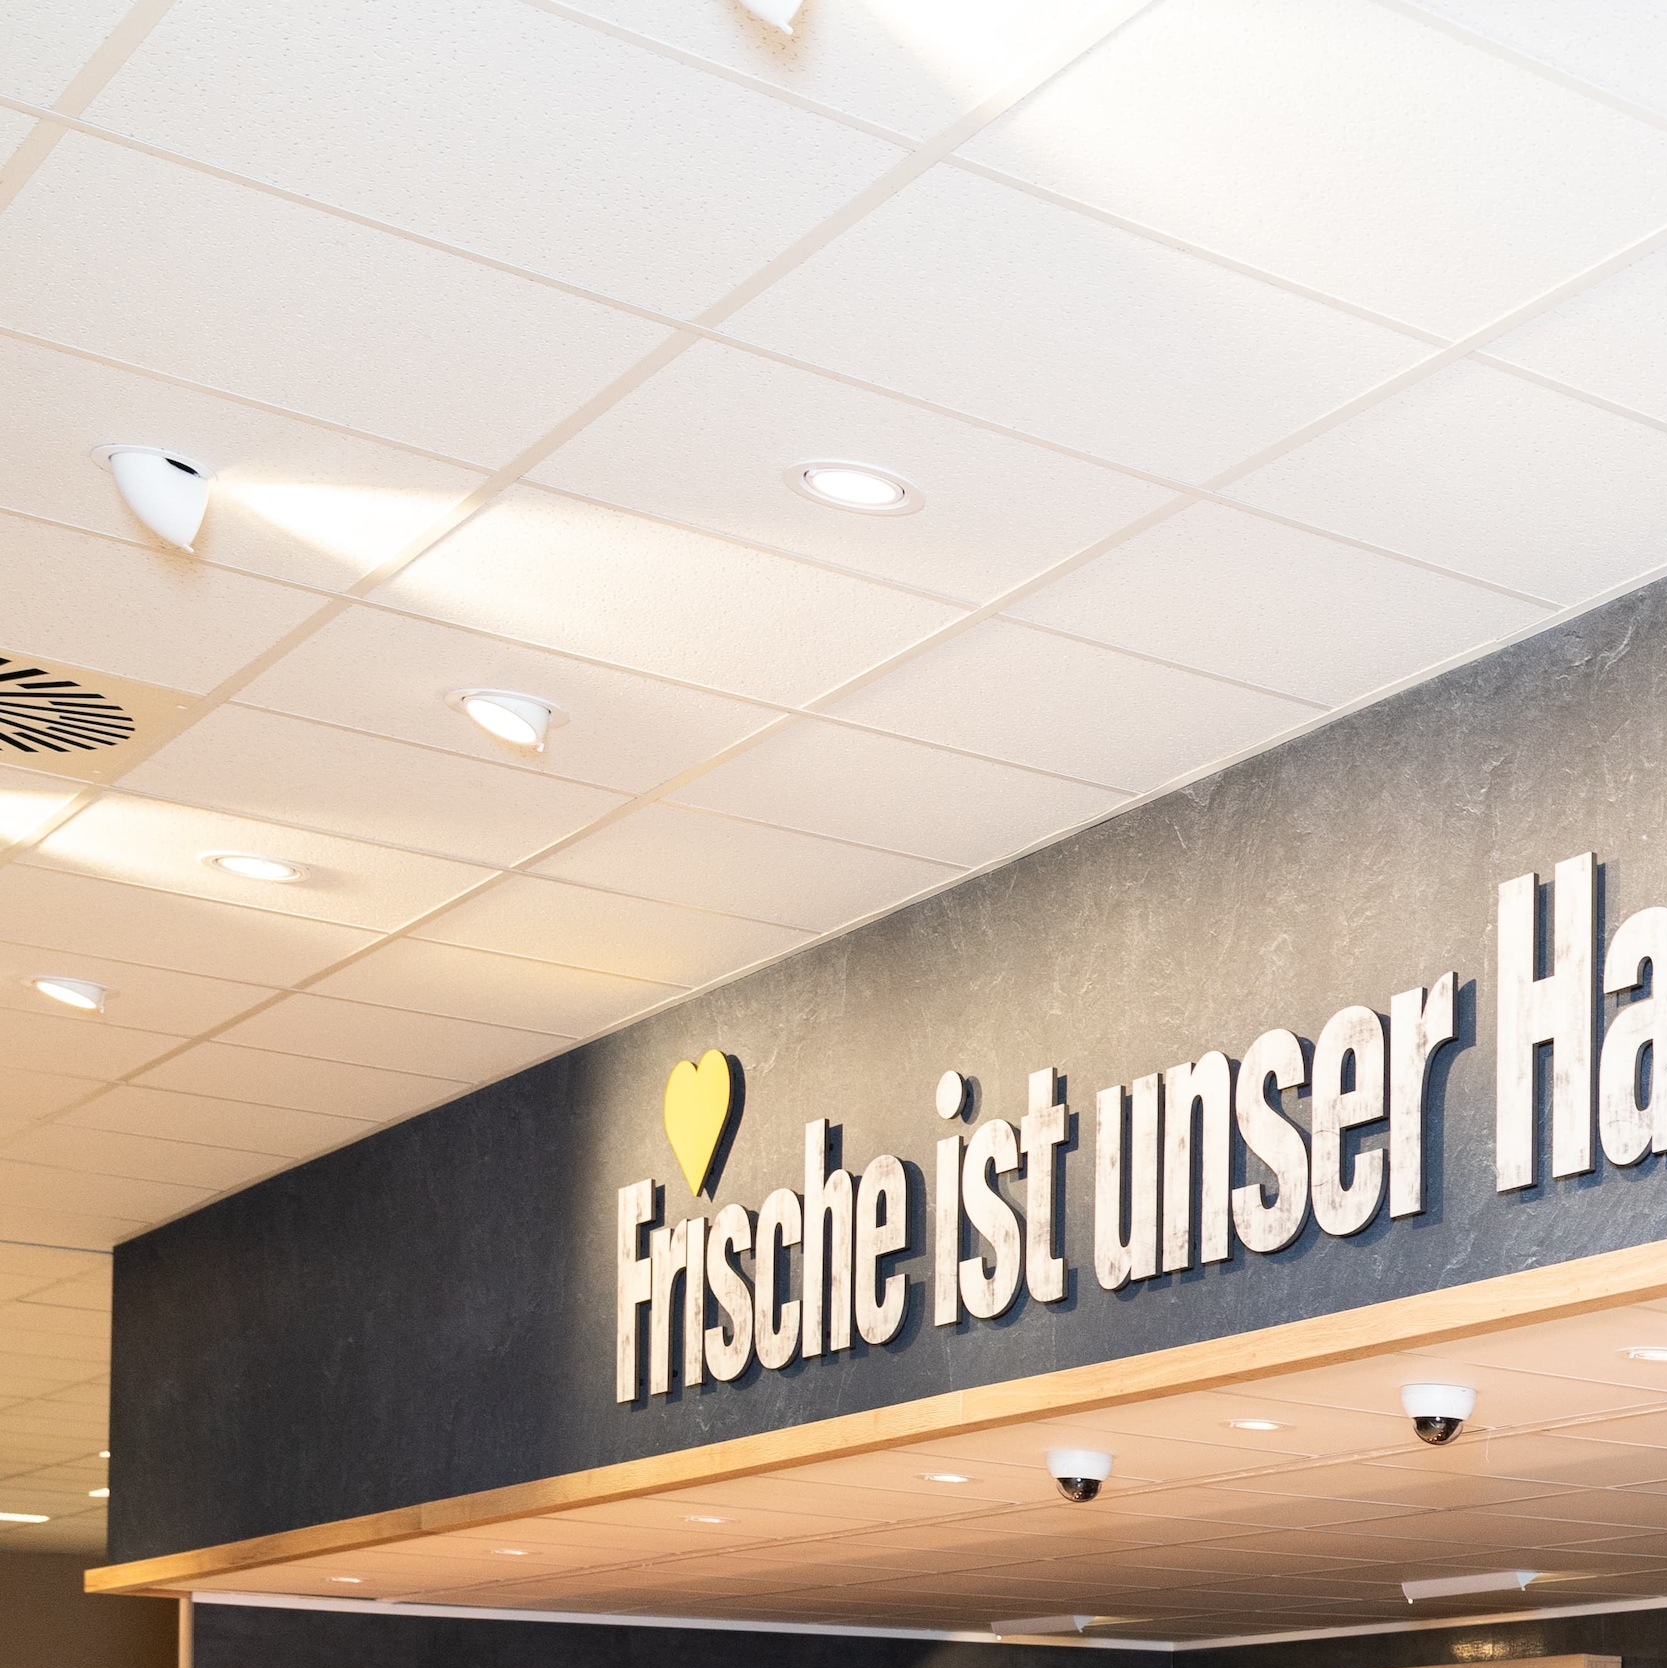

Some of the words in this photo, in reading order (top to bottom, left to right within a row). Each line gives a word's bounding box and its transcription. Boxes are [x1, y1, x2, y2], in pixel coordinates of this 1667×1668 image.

[614, 1115, 911, 1409] Frische
[933, 1066, 1069, 1330] ist
[1093, 970, 1459, 1295] unser
